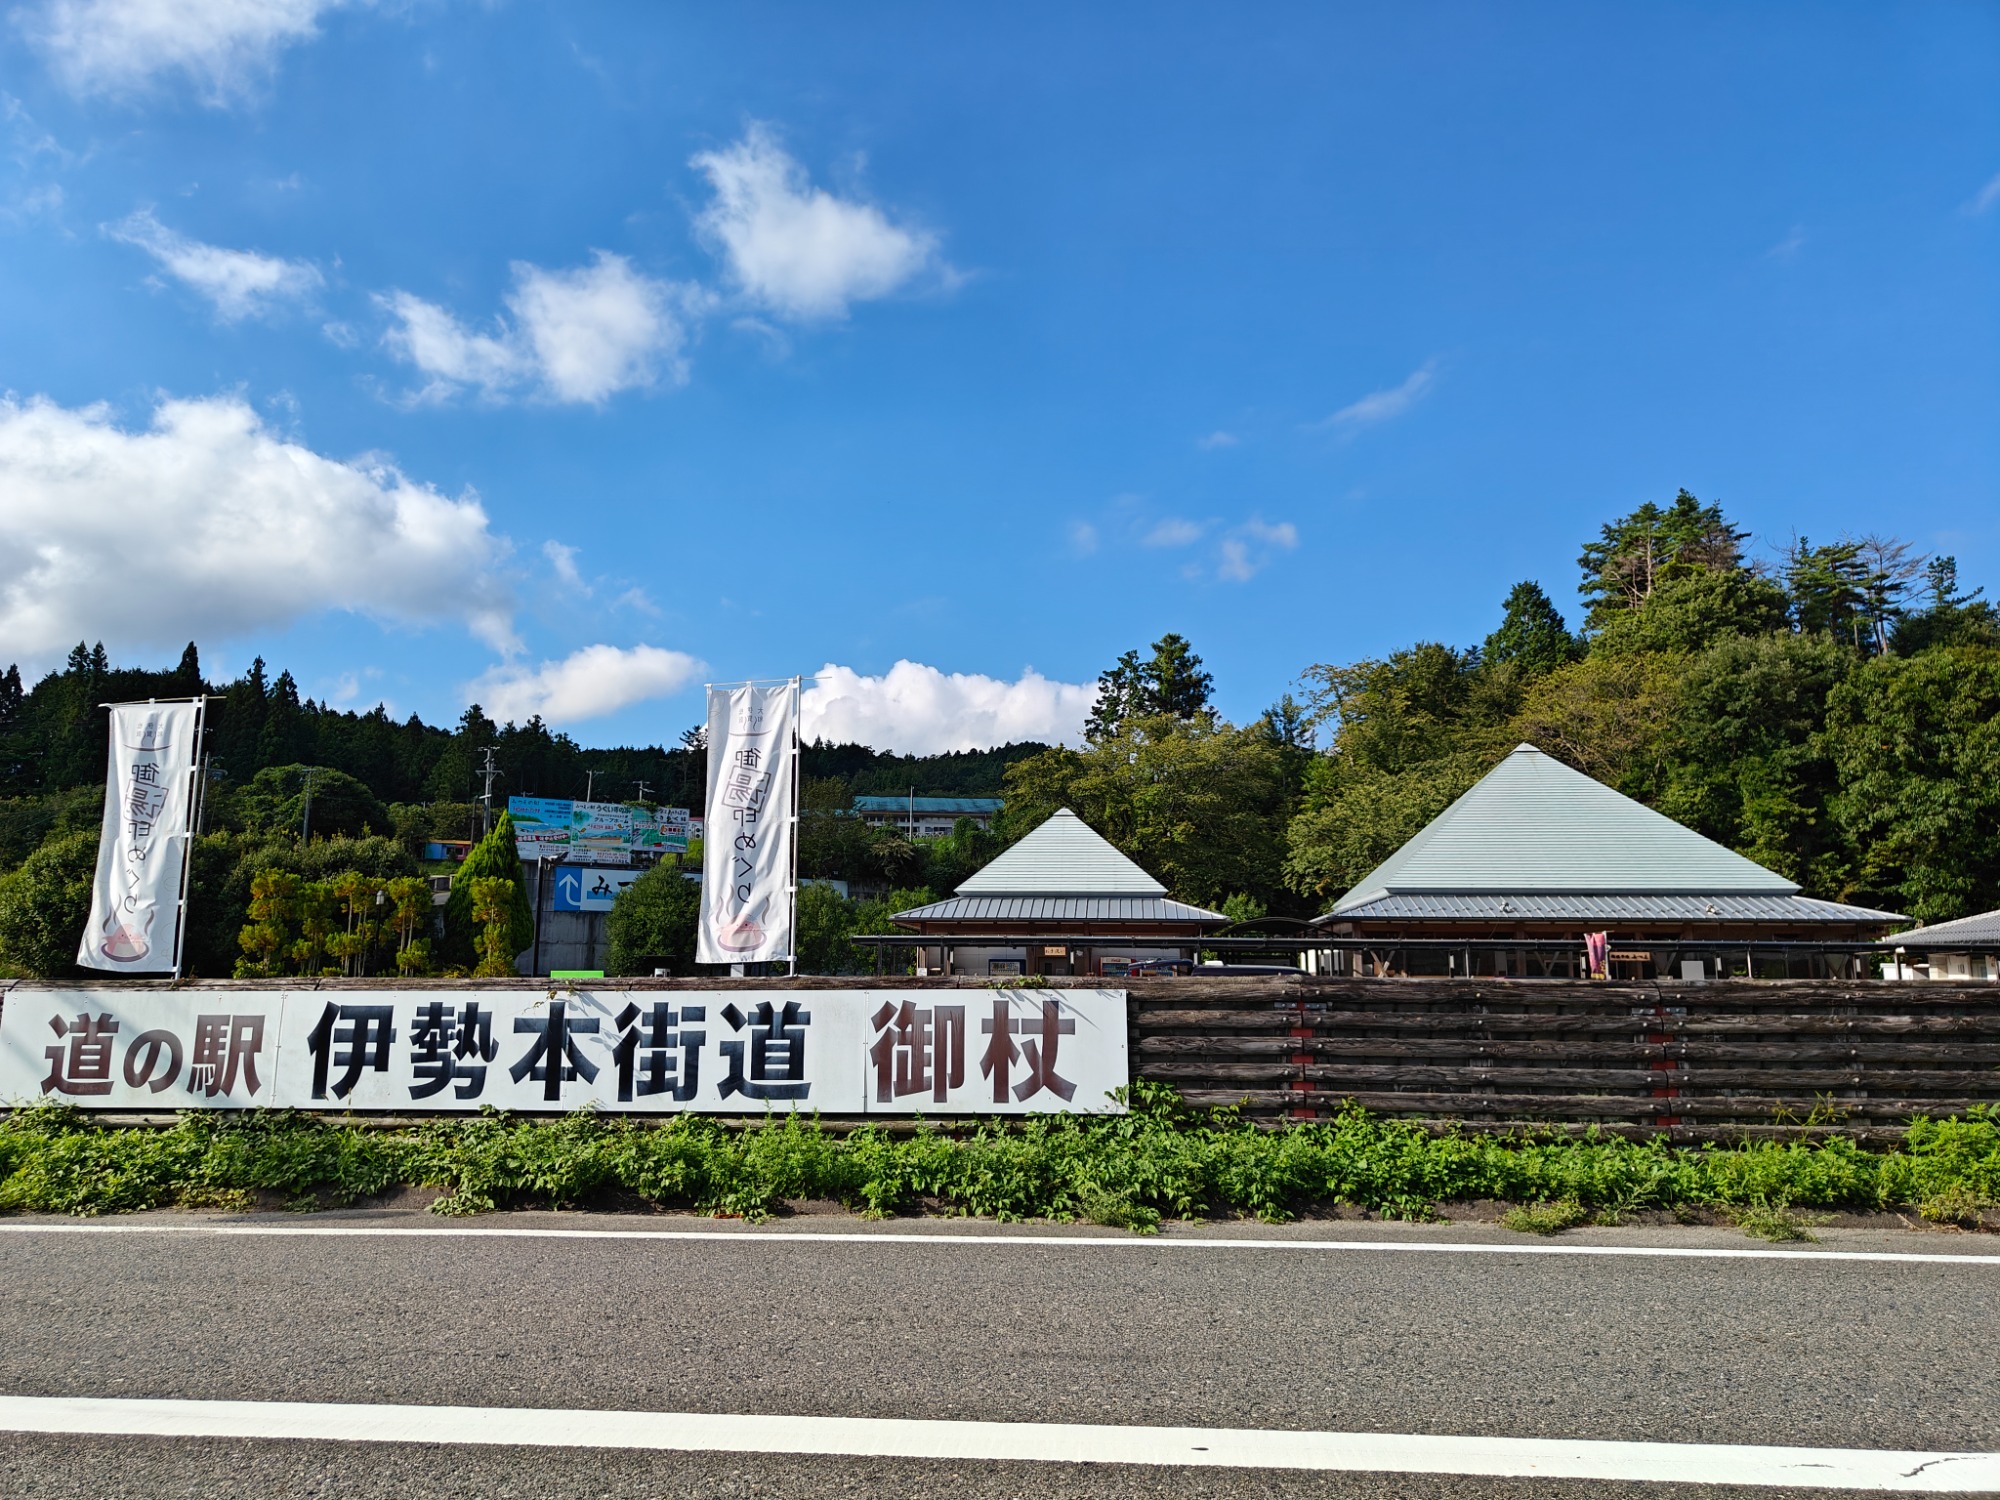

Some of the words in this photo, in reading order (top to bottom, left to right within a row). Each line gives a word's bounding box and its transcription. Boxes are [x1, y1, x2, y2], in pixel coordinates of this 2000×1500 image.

[41, 1012, 266, 1098] 道の駅
[306, 1001, 811, 1102] 伊勢本街道
[869, 1000, 1078, 1104] 御杖
